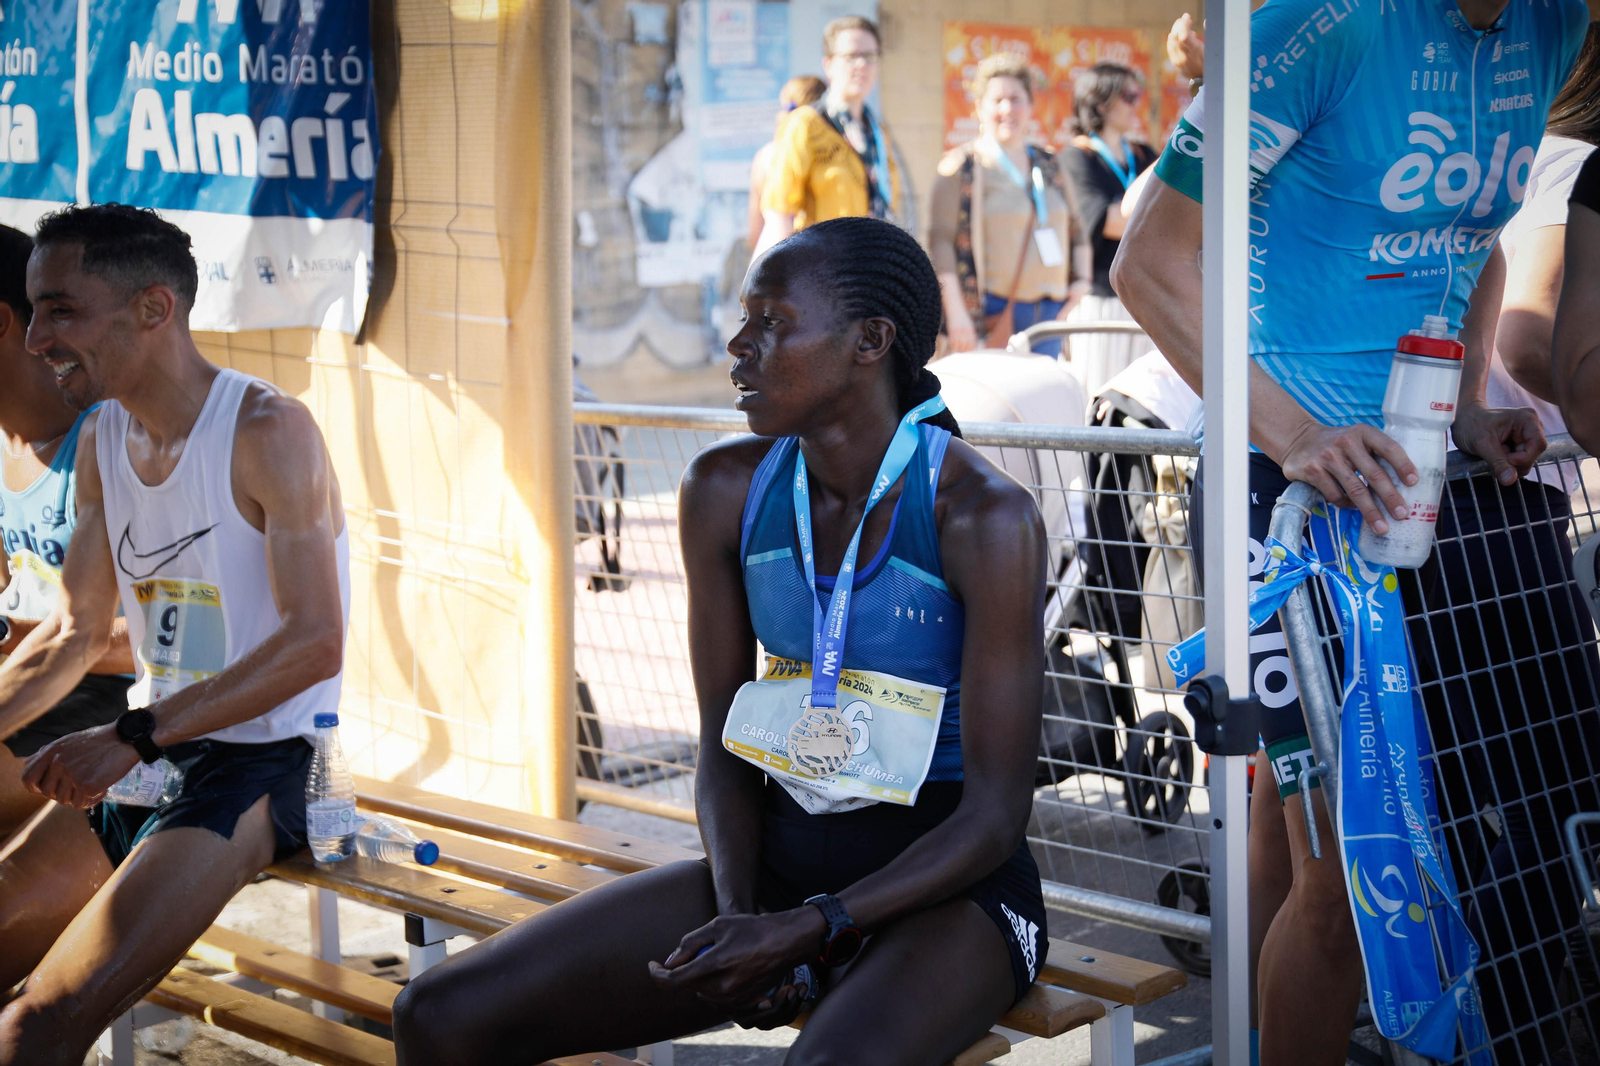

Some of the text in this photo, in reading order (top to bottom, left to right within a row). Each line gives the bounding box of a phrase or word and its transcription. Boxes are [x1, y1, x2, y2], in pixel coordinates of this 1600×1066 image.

[1273, 0, 1360, 74] RETELI
[1504, 41, 1530, 54] elmec
[128, 41, 364, 86] Medio Marató
[1411, 70, 1458, 92] GOBIK
[1493, 68, 1530, 84] ŠKODA
[126, 87, 375, 181] Almería
[1379, 130, 1535, 218] eolo
[1369, 226, 1504, 265] KOMETA
[1412, 267, 1446, 278] ANNO
[157, 605, 178, 647] 9
[828, 588, 844, 638] Medio Maratón
[833, 590, 848, 640] Almería 2024
[852, 680, 874, 697] 2024
[845, 760, 905, 785] CHUMBA
[1001, 903, 1036, 983] adidas
